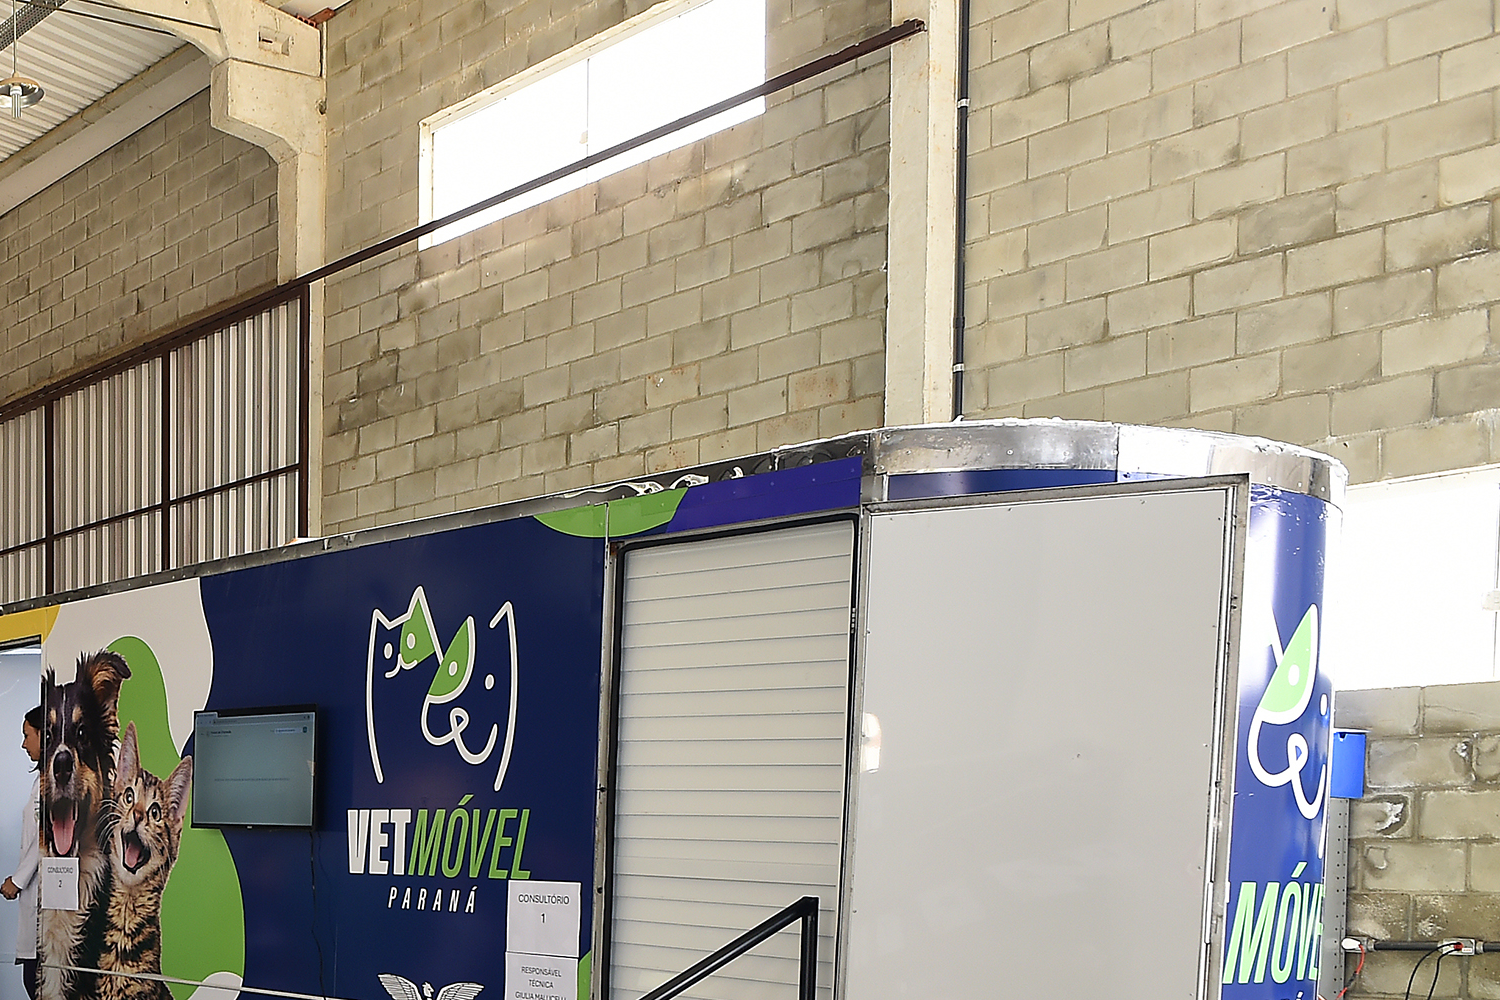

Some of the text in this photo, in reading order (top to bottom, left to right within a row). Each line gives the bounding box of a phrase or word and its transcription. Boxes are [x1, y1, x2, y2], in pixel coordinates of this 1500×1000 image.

[58, 879, 63, 888] 2
[387, 886, 479, 914] PARANÁ
[518, 893, 570, 905] CONSULTÓRIO
[541, 913, 546, 924] 1
[1221, 861, 1325, 985] MÓVE
[515, 991, 534, 1000] GIULIA
